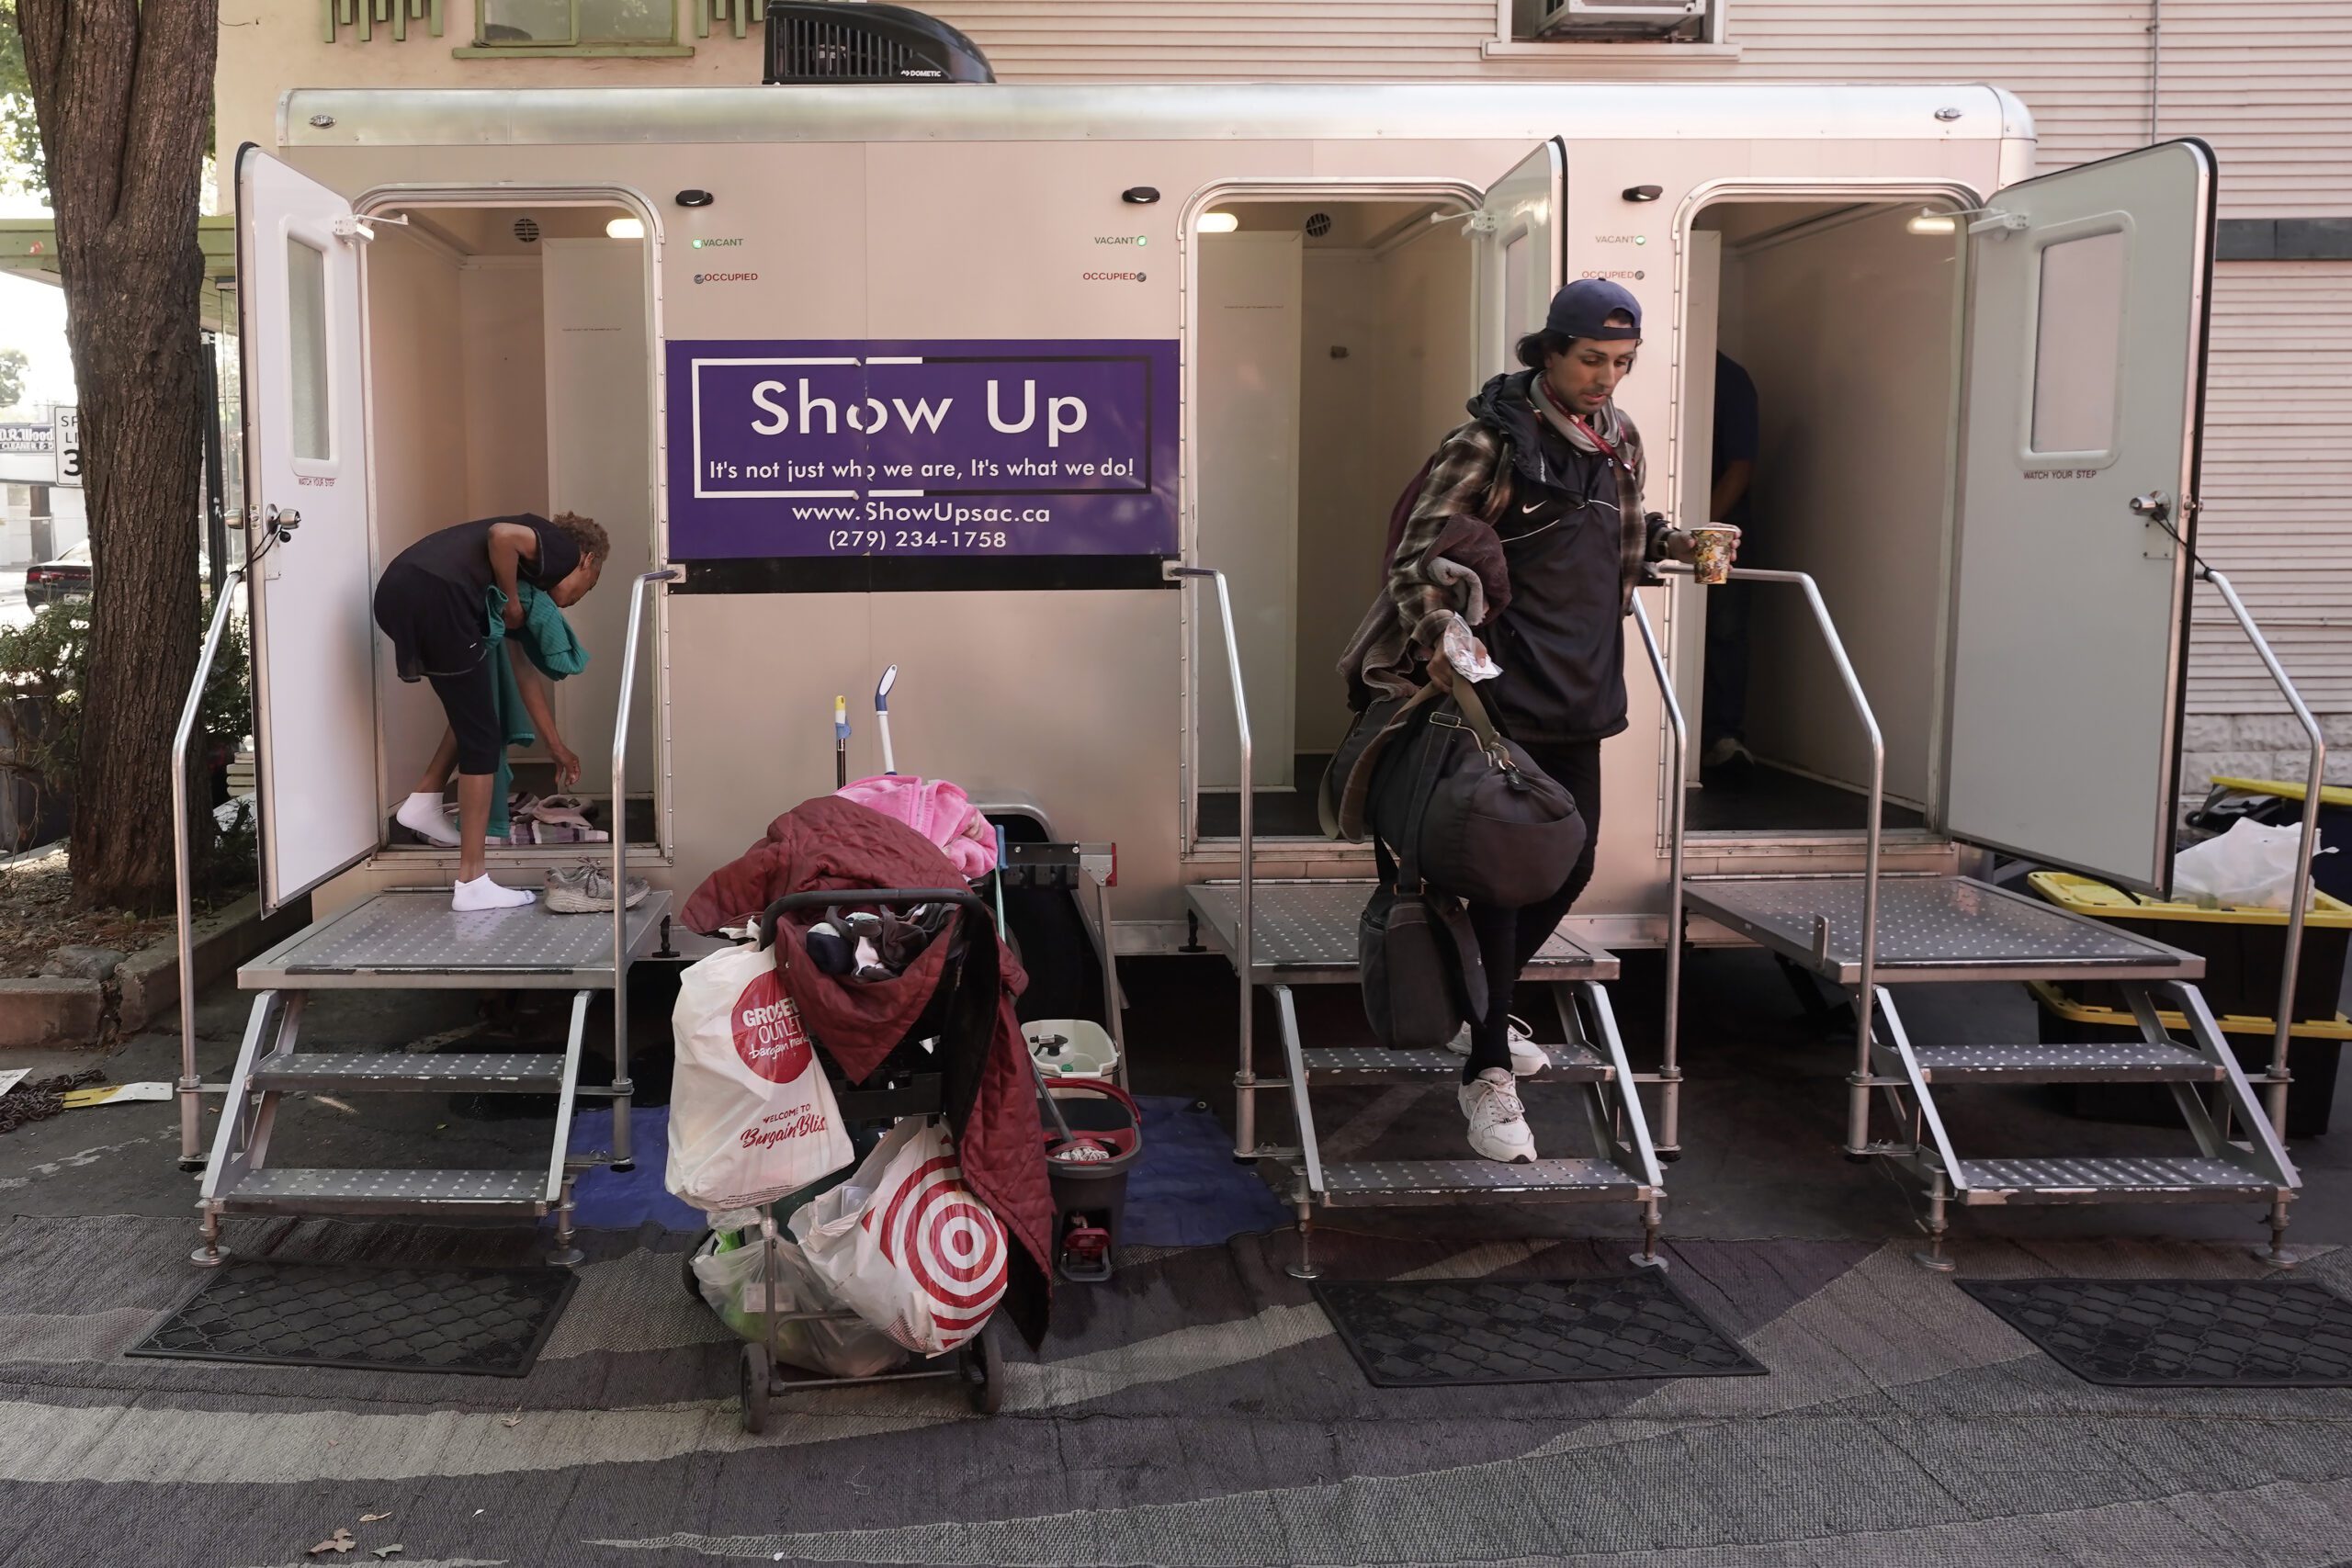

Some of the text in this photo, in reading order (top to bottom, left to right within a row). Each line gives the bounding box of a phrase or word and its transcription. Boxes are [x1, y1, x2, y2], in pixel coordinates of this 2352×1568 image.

[703, 238, 743, 247] VACANT
[1094, 236, 1136, 244] VACANT
[1595, 235, 1634, 243] VACANT
[704, 273, 759, 281] OCCUPIED
[1082, 272, 1136, 280] OCCUPIED
[1581, 270, 1634, 279] OCCUPIED
[751, 378, 1088, 447] Show Up
[709, 461, 739, 479] It's
[745, 462, 780, 478] not
[786, 460, 825, 482] just
[883, 464, 914, 477] we
[921, 465, 963, 479] are,
[971, 458, 1000, 476] It's
[1007, 457, 1058, 476] what
[1065, 463, 1095, 476] we
[1100, 457, 1135, 476] do!
[2023, 469, 2097, 479] WATCH YOUR STEP
[791, 502, 1050, 525] www.ShowUpsac.ca
[829, 530, 1007, 550] (279) 234-1758
[741, 997, 799, 1028] GROCER
[749, 1041, 789, 1060] bargain
[763, 1103, 811, 1124] WELCOME TO
[740, 1112, 829, 1150] Bargain Blis
